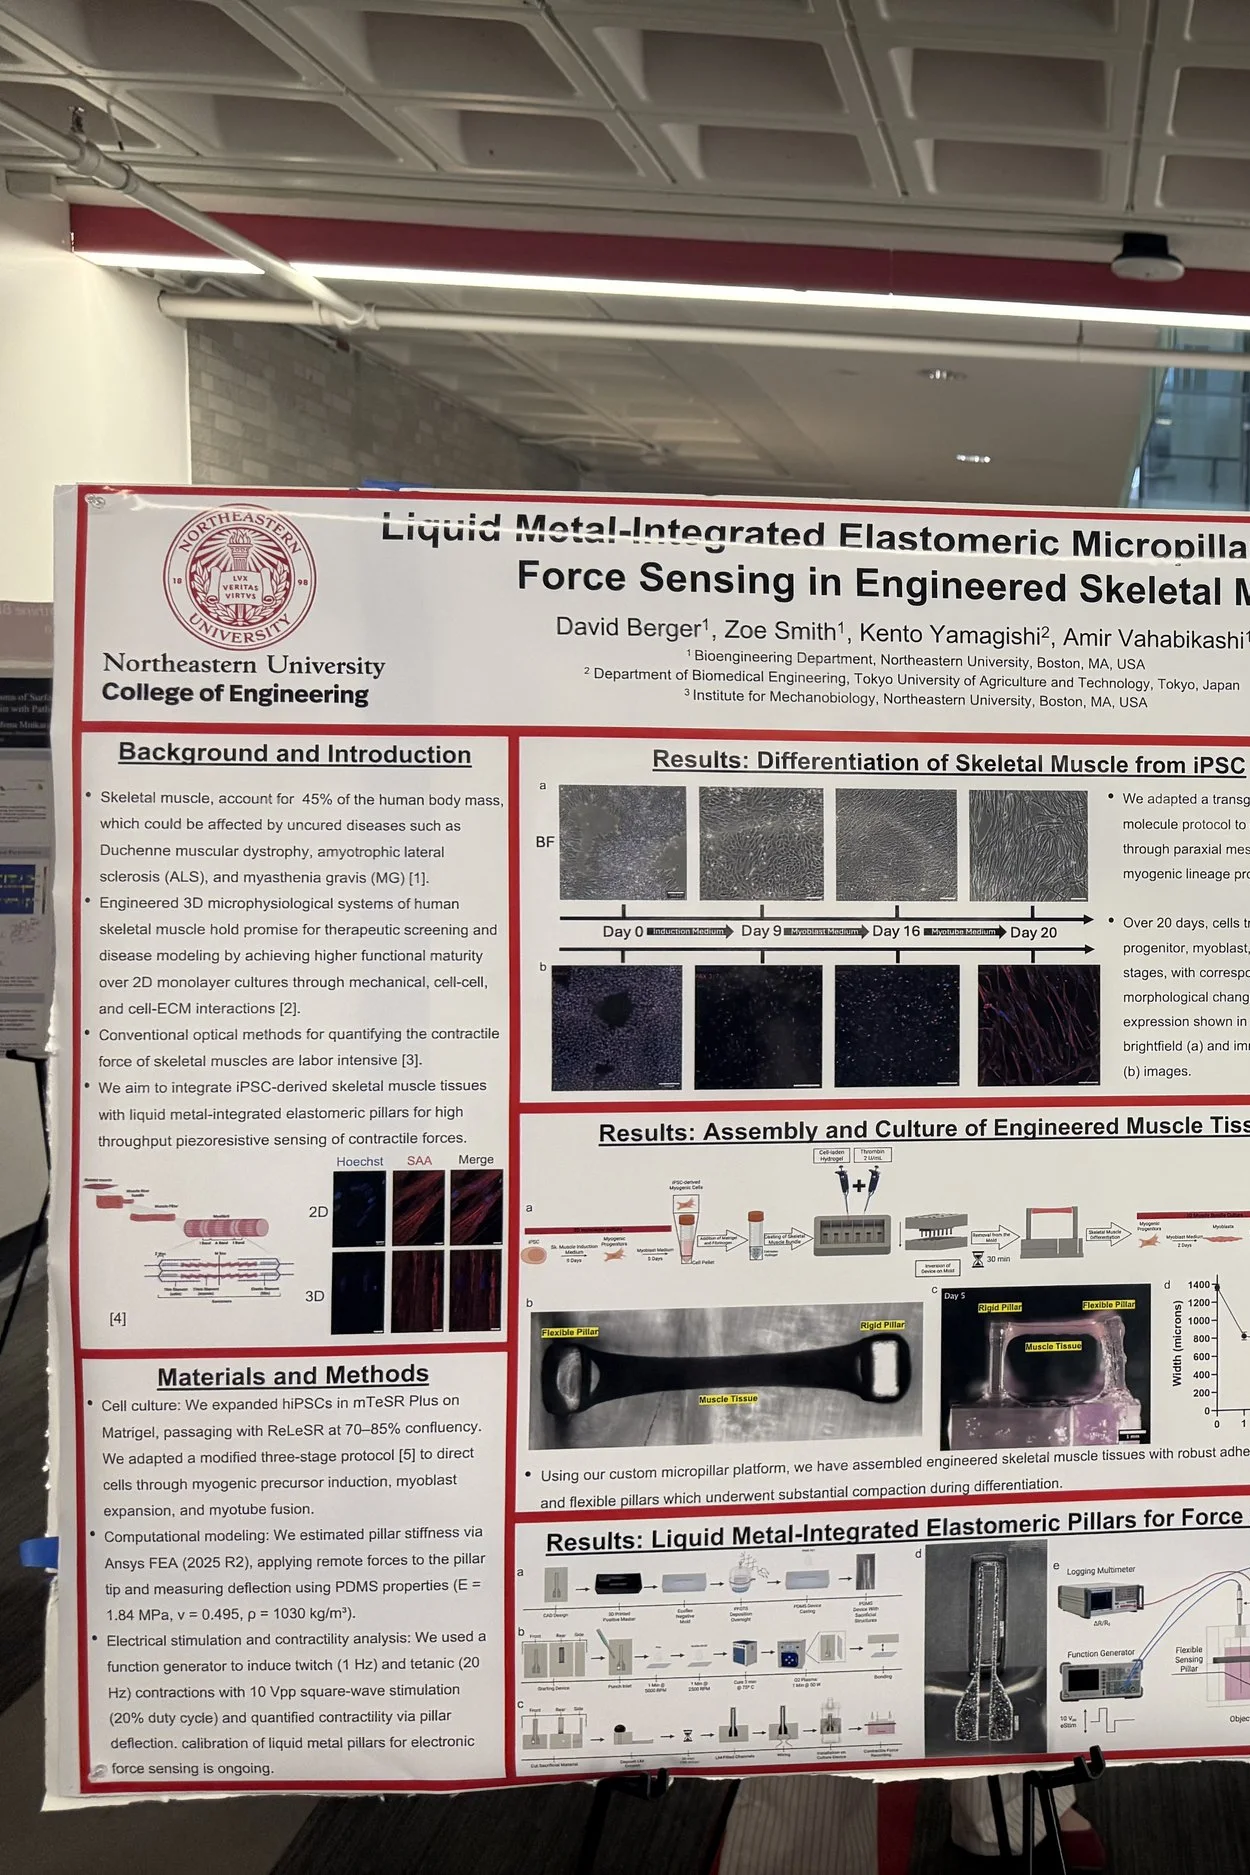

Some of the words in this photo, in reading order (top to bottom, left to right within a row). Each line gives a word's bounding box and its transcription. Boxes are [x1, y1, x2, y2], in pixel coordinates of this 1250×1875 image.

[178, 511, 302, 555] NORTHEASTERN
[381, 511, 502, 548] Liquid
[516, 513, 826, 554] Metal-Integrated
[839, 521, 1060, 562] Elastomeric
[172, 577, 183, 585] 18
[222, 584, 259, 592] VERITAS
[518, 559, 626, 592] Force
[639, 561, 795, 604] Sensing
[809, 565, 841, 597] in
[856, 567, 1066, 608] Engineered
[1079, 573, 1221, 607] Skeletal
[189, 612, 292, 645] UNIVERSITY
[556, 616, 619, 638] David
[627, 616, 717, 644] Berger1,
[724, 618, 767, 641] Zoe
[774, 619, 852, 646] Smith1,
[860, 621, 923, 644] Kento
[929, 623, 1056, 651] Yamagishi2,
[1062, 626, 1113, 648] Amir
[102, 648, 258, 675] Northeastern
[266, 654, 387, 680] University
[687, 648, 691, 658] 1
[694, 649, 793, 667] Bioengineering
[797, 650, 876, 668] Department,
[880, 652, 963, 668] Northeastern
[967, 654, 1033, 671] University,
[1037, 656, 1084, 671] Boston,
[1088, 656, 1113, 673] MA,
[1117, 657, 1146, 670] USA
[101, 681, 195, 707] College
[199, 682, 225, 703] of
[229, 682, 370, 709] Engineering
[119, 741, 268, 767] Background
[276, 742, 320, 764] and
[328, 743, 471, 765] Introduction
[653, 748, 749, 770] Results:
[757, 749, 919, 773] Differentiation
[926, 752, 950, 772] of
[955, 752, 1043, 774] Skeletal
[1051, 753, 1129, 775] Muscle
[1134, 754, 1186, 775] from
[1193, 755, 1246, 775] iPSC
[100, 790, 156, 805] Skeletal
[160, 790, 214, 807] muscle,
[218, 792, 273, 806] account
[276, 791, 295, 805] for
[301, 792, 333, 807] 45%
[336, 793, 351, 807] of
[353, 792, 375, 806] the
[379, 792, 425, 807] human
[428, 793, 462, 810] body
[464, 795, 504, 808] mass,
[1122, 792, 1144, 806] We
[1147, 793, 1198, 808] adapted
[1201, 795, 1209, 806] a
[536, 836, 555, 848] BF
[603, 926, 632, 939] Day
[635, 926, 644, 937] 0
[741, 925, 771, 939] Day
[773, 925, 782, 937] 9
[873, 925, 902, 939] Day
[905, 925, 920, 937] 16
[1010, 926, 1038, 941] Day
[1040, 926, 1057, 939] 20
[599, 1122, 695, 1143] Results:
[702, 1119, 819, 1145] Assembly
[825, 1119, 868, 1141] and
[875, 1118, 958, 1140] Culture
[964, 1117, 988, 1138] of
[994, 1116, 1119, 1141] Engineered
[1126, 1115, 1203, 1136] Muscle
[336, 1155, 383, 1167] Hoechst
[407, 1155, 432, 1166] SAA
[458, 1154, 494, 1166] Merge
[309, 1206, 329, 1218] 2D
[987, 1255, 996, 1263] 30
[998, 1255, 1011, 1263] min
[1188, 1281, 1211, 1289] 1400
[305, 1290, 325, 1302] 3D
[944, 1292, 960, 1300] Day
[542, 1329, 574, 1338] Flexible
[575, 1328, 599, 1336] Pillar
[861, 1321, 881, 1330] Rigid
[882, 1321, 906, 1329] Pillar
[1173, 1300, 1184, 1353] (microns)
[158, 1365, 266, 1388] Materials
[273, 1364, 317, 1387] and
[325, 1363, 429, 1386] Methods
[1173, 1355, 1182, 1386] Width
[700, 1395, 728, 1403] Muscle
[731, 1394, 758, 1402] Tissue
[102, 1425, 159, 1442] Matrigel,
[163, 1424, 233, 1442] passaging
[236, 1424, 264, 1438] with
[267, 1422, 325, 1438] ReLeSR
[328, 1423, 342, 1437] at
[345, 1421, 401, 1437] 70–85%
[405, 1419, 482, 1436] confluency.
[546, 1530, 643, 1552] Results:
[652, 1525, 724, 1553] Liquid
[732, 1517, 919, 1549] Metal-Integrated
[926, 1512, 1061, 1538] Elastomeric
[1068, 1510, 1137, 1533] Pillars
[1143, 1507, 1176, 1530] for
[1181, 1506, 1244, 1529] Force
[1067, 1568, 1096, 1576] Logging
[1175, 1656, 1203, 1664] Sensing
